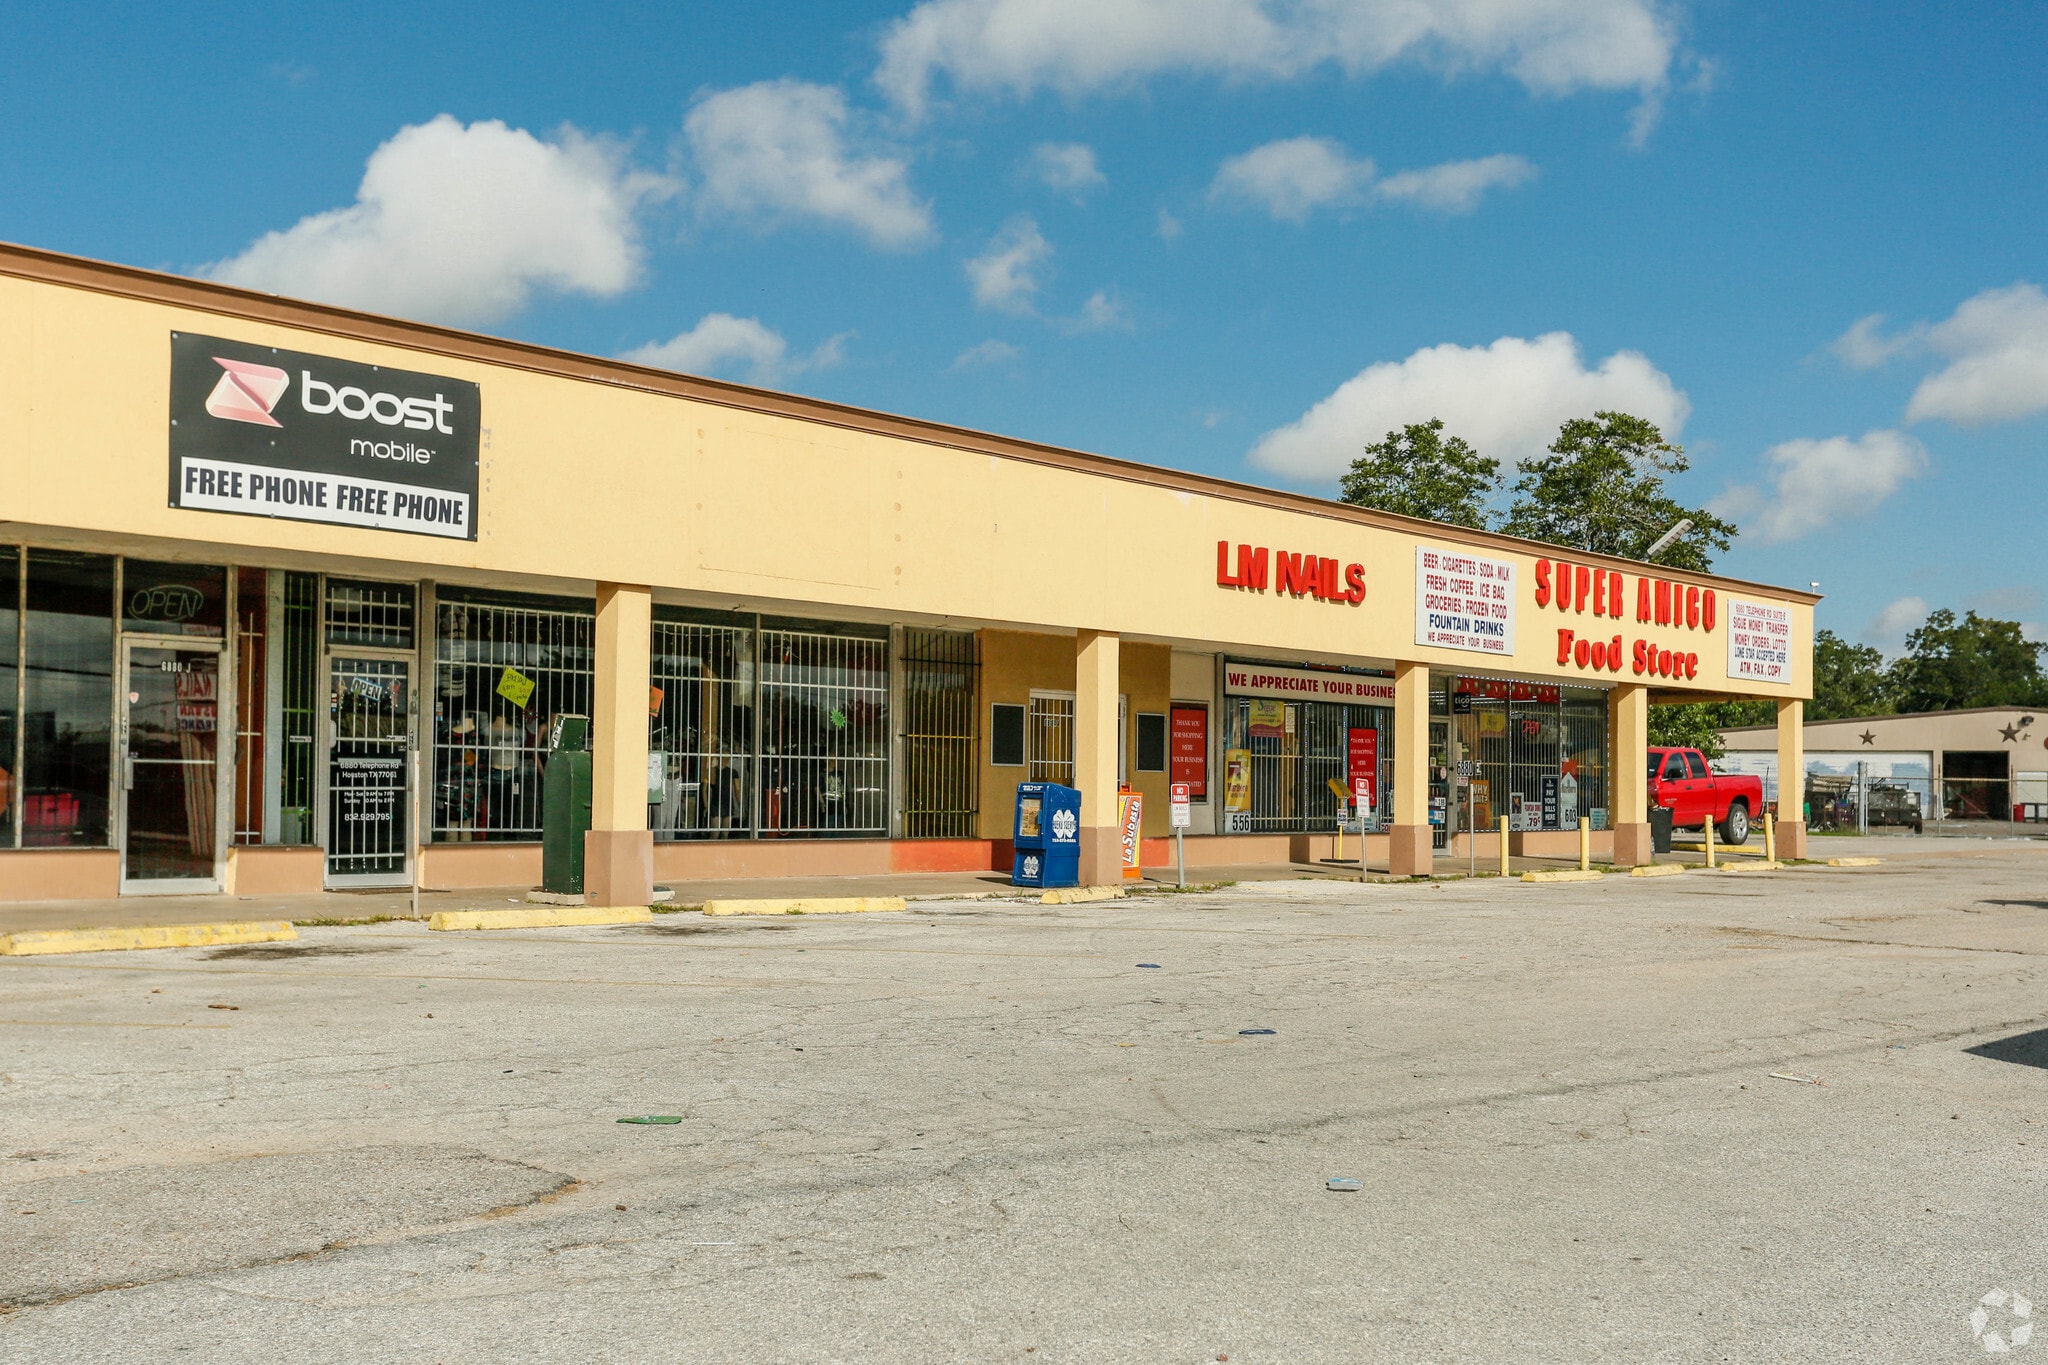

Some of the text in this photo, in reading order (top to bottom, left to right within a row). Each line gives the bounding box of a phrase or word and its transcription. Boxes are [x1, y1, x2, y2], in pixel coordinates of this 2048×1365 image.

[301, 370, 453, 434] boost
[350, 438, 431, 464] mobile
[185, 466, 463, 525] FREE PHONE FREE PHONE
[1216, 540, 1366, 603] LM NAILS
[1497, 565, 1510, 581] MILK
[1426, 574, 1447, 592] FRESH
[1480, 583, 1490, 598] ICE
[1493, 584, 1505, 600] BAG
[1535, 558, 1716, 632] SUPER AMIGO
[131, 590, 198, 618] OPEN
[1466, 599, 1489, 616] FROZEN
[1491, 603, 1507, 619] FOOD
[1746, 605, 1766, 617] TELEPHONE
[1429, 613, 1504, 637] FOUNTAIN DRINKS
[1749, 619, 1763, 632] MONEY
[1766, 621, 1788, 636] TRANSFER
[1427, 632, 1504, 650] WE APPRECIATE YOUR BUSINESS
[1734, 633, 1750, 646] MONEY
[1772, 638, 1787, 651] LOTTO
[1557, 628, 1698, 679] Food Store
[1734, 647, 1786, 663] LONE STAR ACCEPTED HERE
[161, 661, 183, 672] 6880
[1768, 664, 1781, 677] COPY
[353, 679, 380, 700] OPEN
[1228, 672, 1247, 687] WE
[1251, 674, 1319, 692] APPRECIATE
[1323, 680, 1353, 695] YOUR
[360, 762, 390, 770] Telephone
[1457, 761, 1474, 776] 6880
[1232, 815, 1250, 831] 556
[1565, 809, 1577, 822] 603
[1122, 800, 1140, 863] La Subasta
